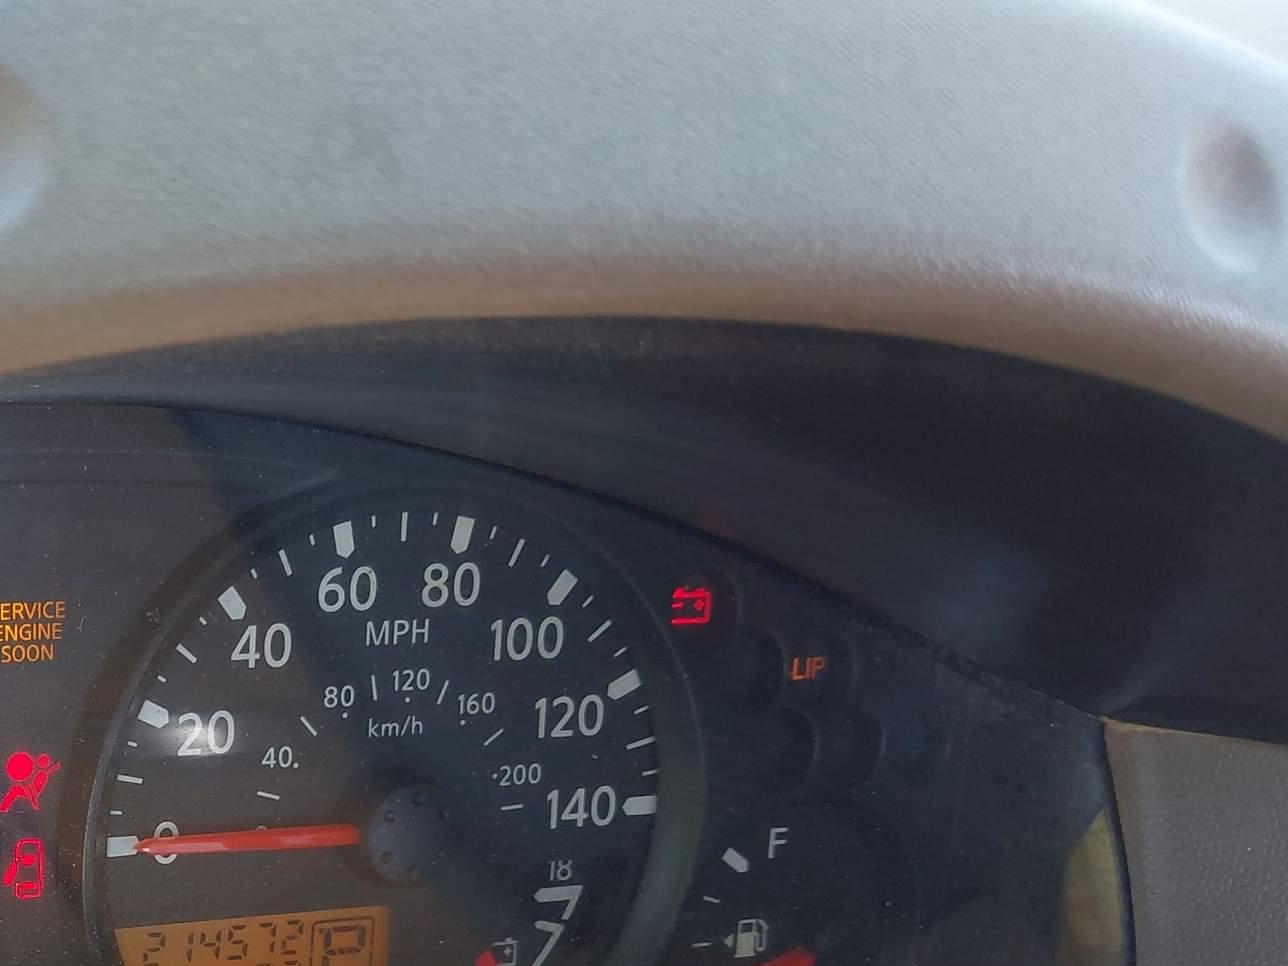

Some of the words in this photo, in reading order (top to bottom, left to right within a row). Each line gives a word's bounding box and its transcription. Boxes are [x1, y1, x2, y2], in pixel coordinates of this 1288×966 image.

[319, 567, 376, 612] 60
[422, 563, 480, 607] 80
[231, 624, 292, 668] 40
[366, 619, 429, 646] MPH
[491, 617, 563, 660] 100
[0, 643, 55, 663] SOON
[393, 669, 429, 691] 120
[324, 686, 354, 707] 80
[458, 693, 494, 714] 160
[369, 716, 422, 737] km/h
[535, 696, 605, 739] 120
[178, 711, 233, 755] 20
[499, 764, 541, 786] 200
[547, 786, 615, 829] 140
[768, 828, 788, 858] F
